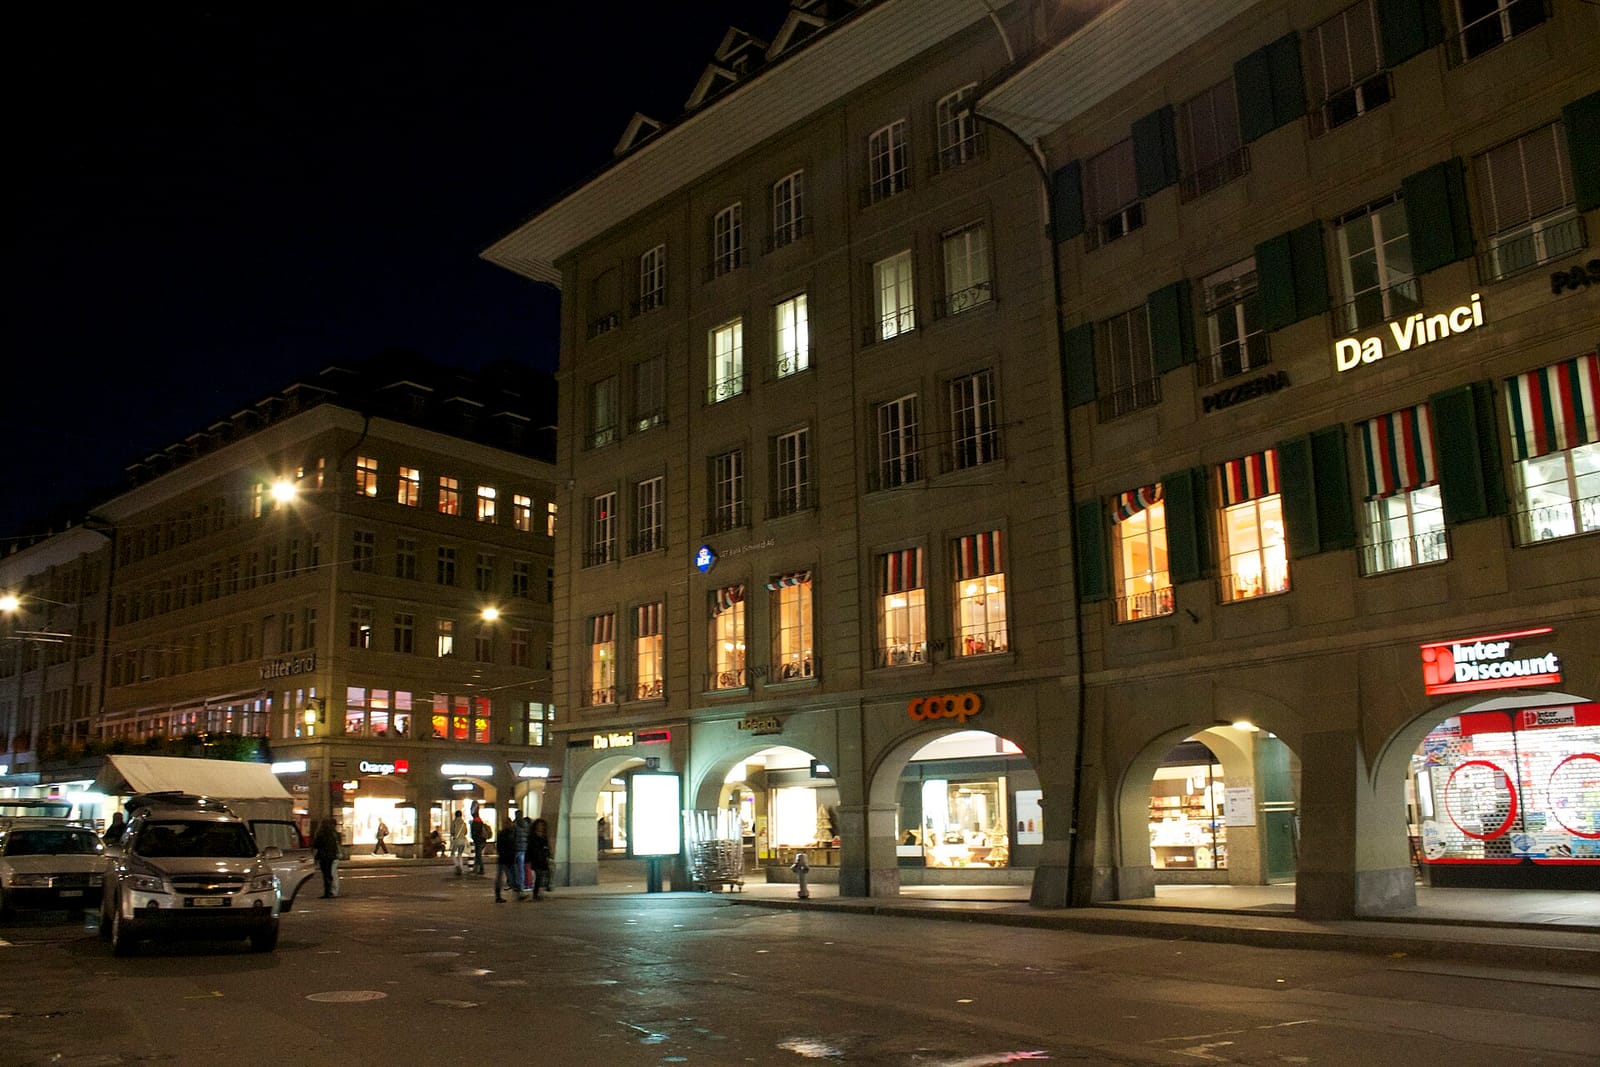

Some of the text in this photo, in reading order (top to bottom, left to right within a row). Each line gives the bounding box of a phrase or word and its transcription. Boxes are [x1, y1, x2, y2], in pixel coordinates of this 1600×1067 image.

[1335, 293, 1484, 372] Da Vinci
[1452, 641, 1510, 663] Inter
[1454, 652, 1560, 682] Discount
[907, 692, 981, 723] coop
[1537, 715, 1574, 725] Discount
[593, 734, 608, 749] Da
[608, 731, 634, 748] Vinci
[359, 761, 395, 775] Orange
